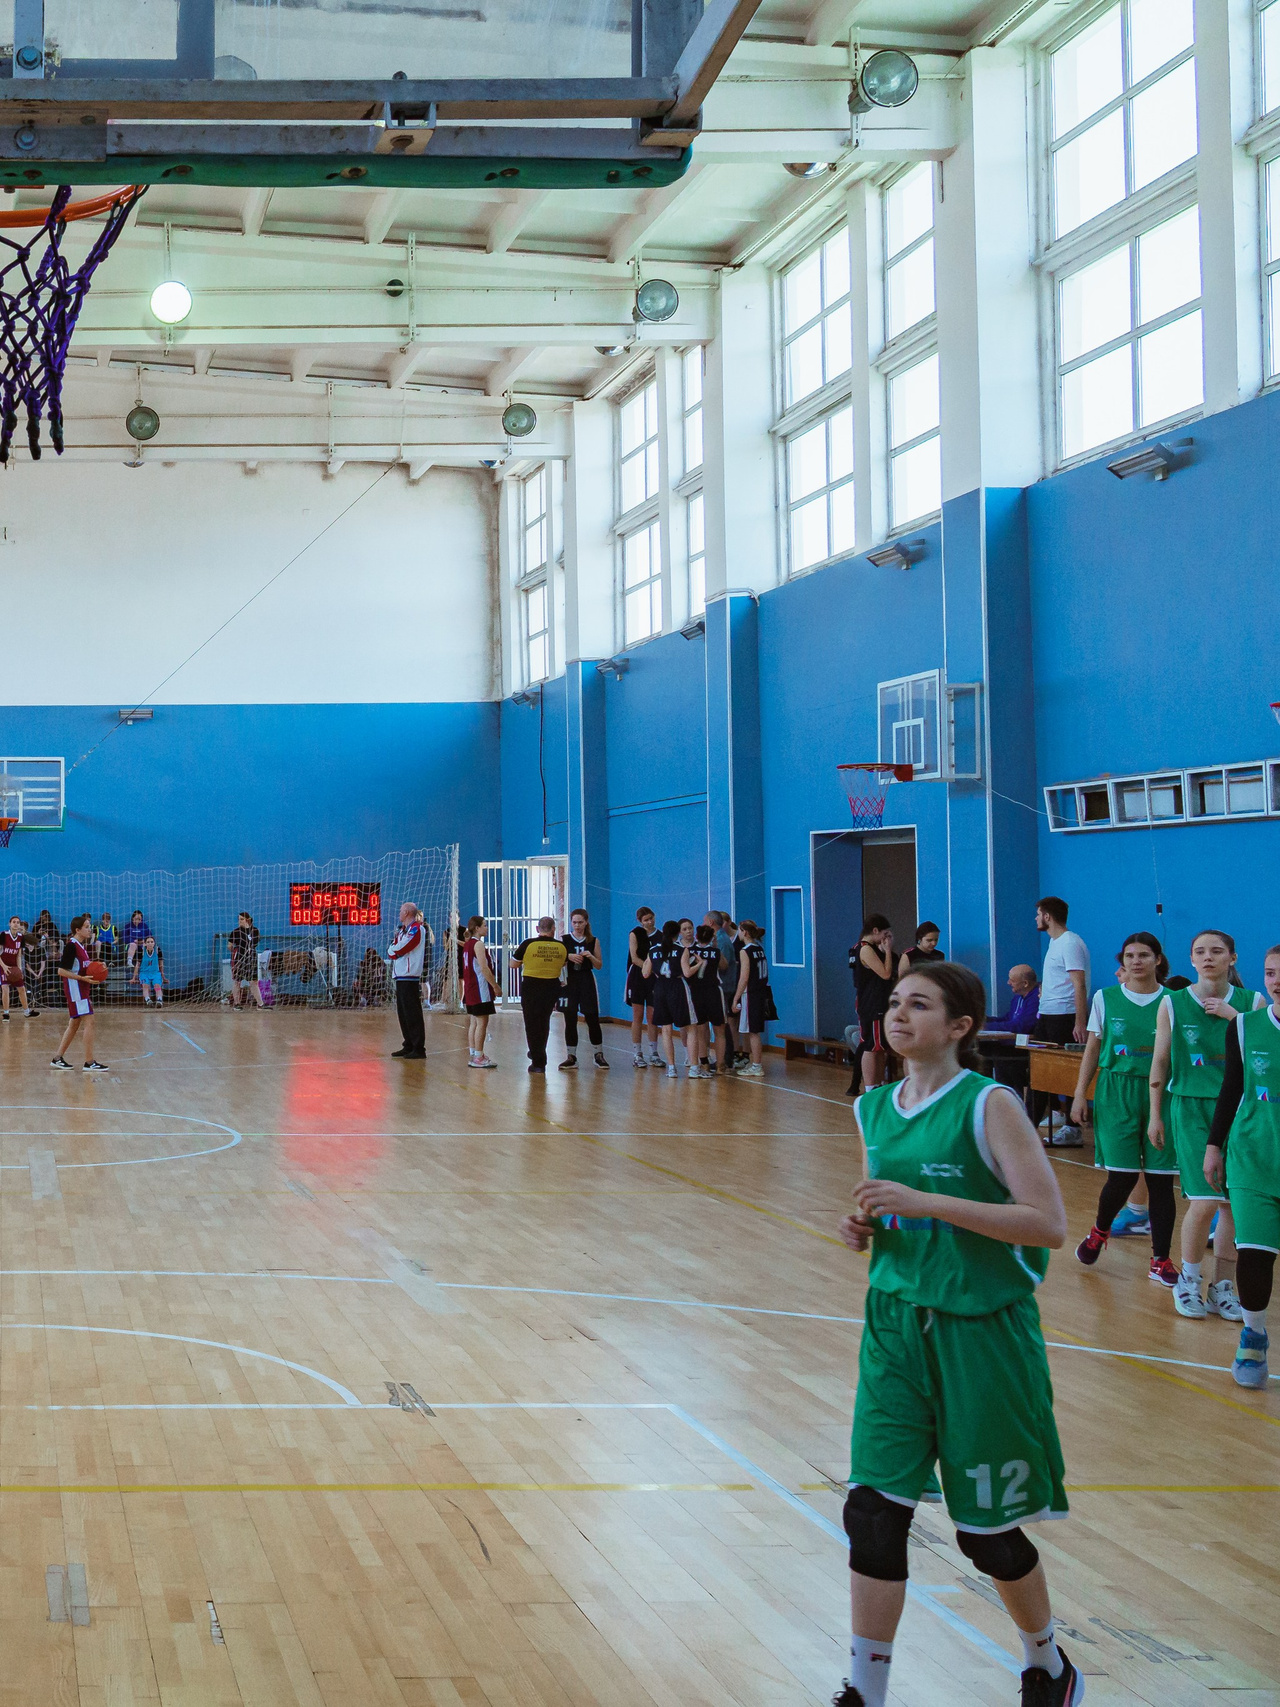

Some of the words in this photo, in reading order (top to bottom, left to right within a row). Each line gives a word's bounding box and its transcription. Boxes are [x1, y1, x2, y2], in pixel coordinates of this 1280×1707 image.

[293, 894, 300, 907] 0
[313, 894, 357, 907] 05:00
[370, 894, 378, 907] 0
[293, 910, 320, 923] 009
[350, 910, 378, 923] 029
[660, 960, 671, 978] 4
[559, 997, 569, 1007] 11
[965, 1459, 1030, 1510] 12
